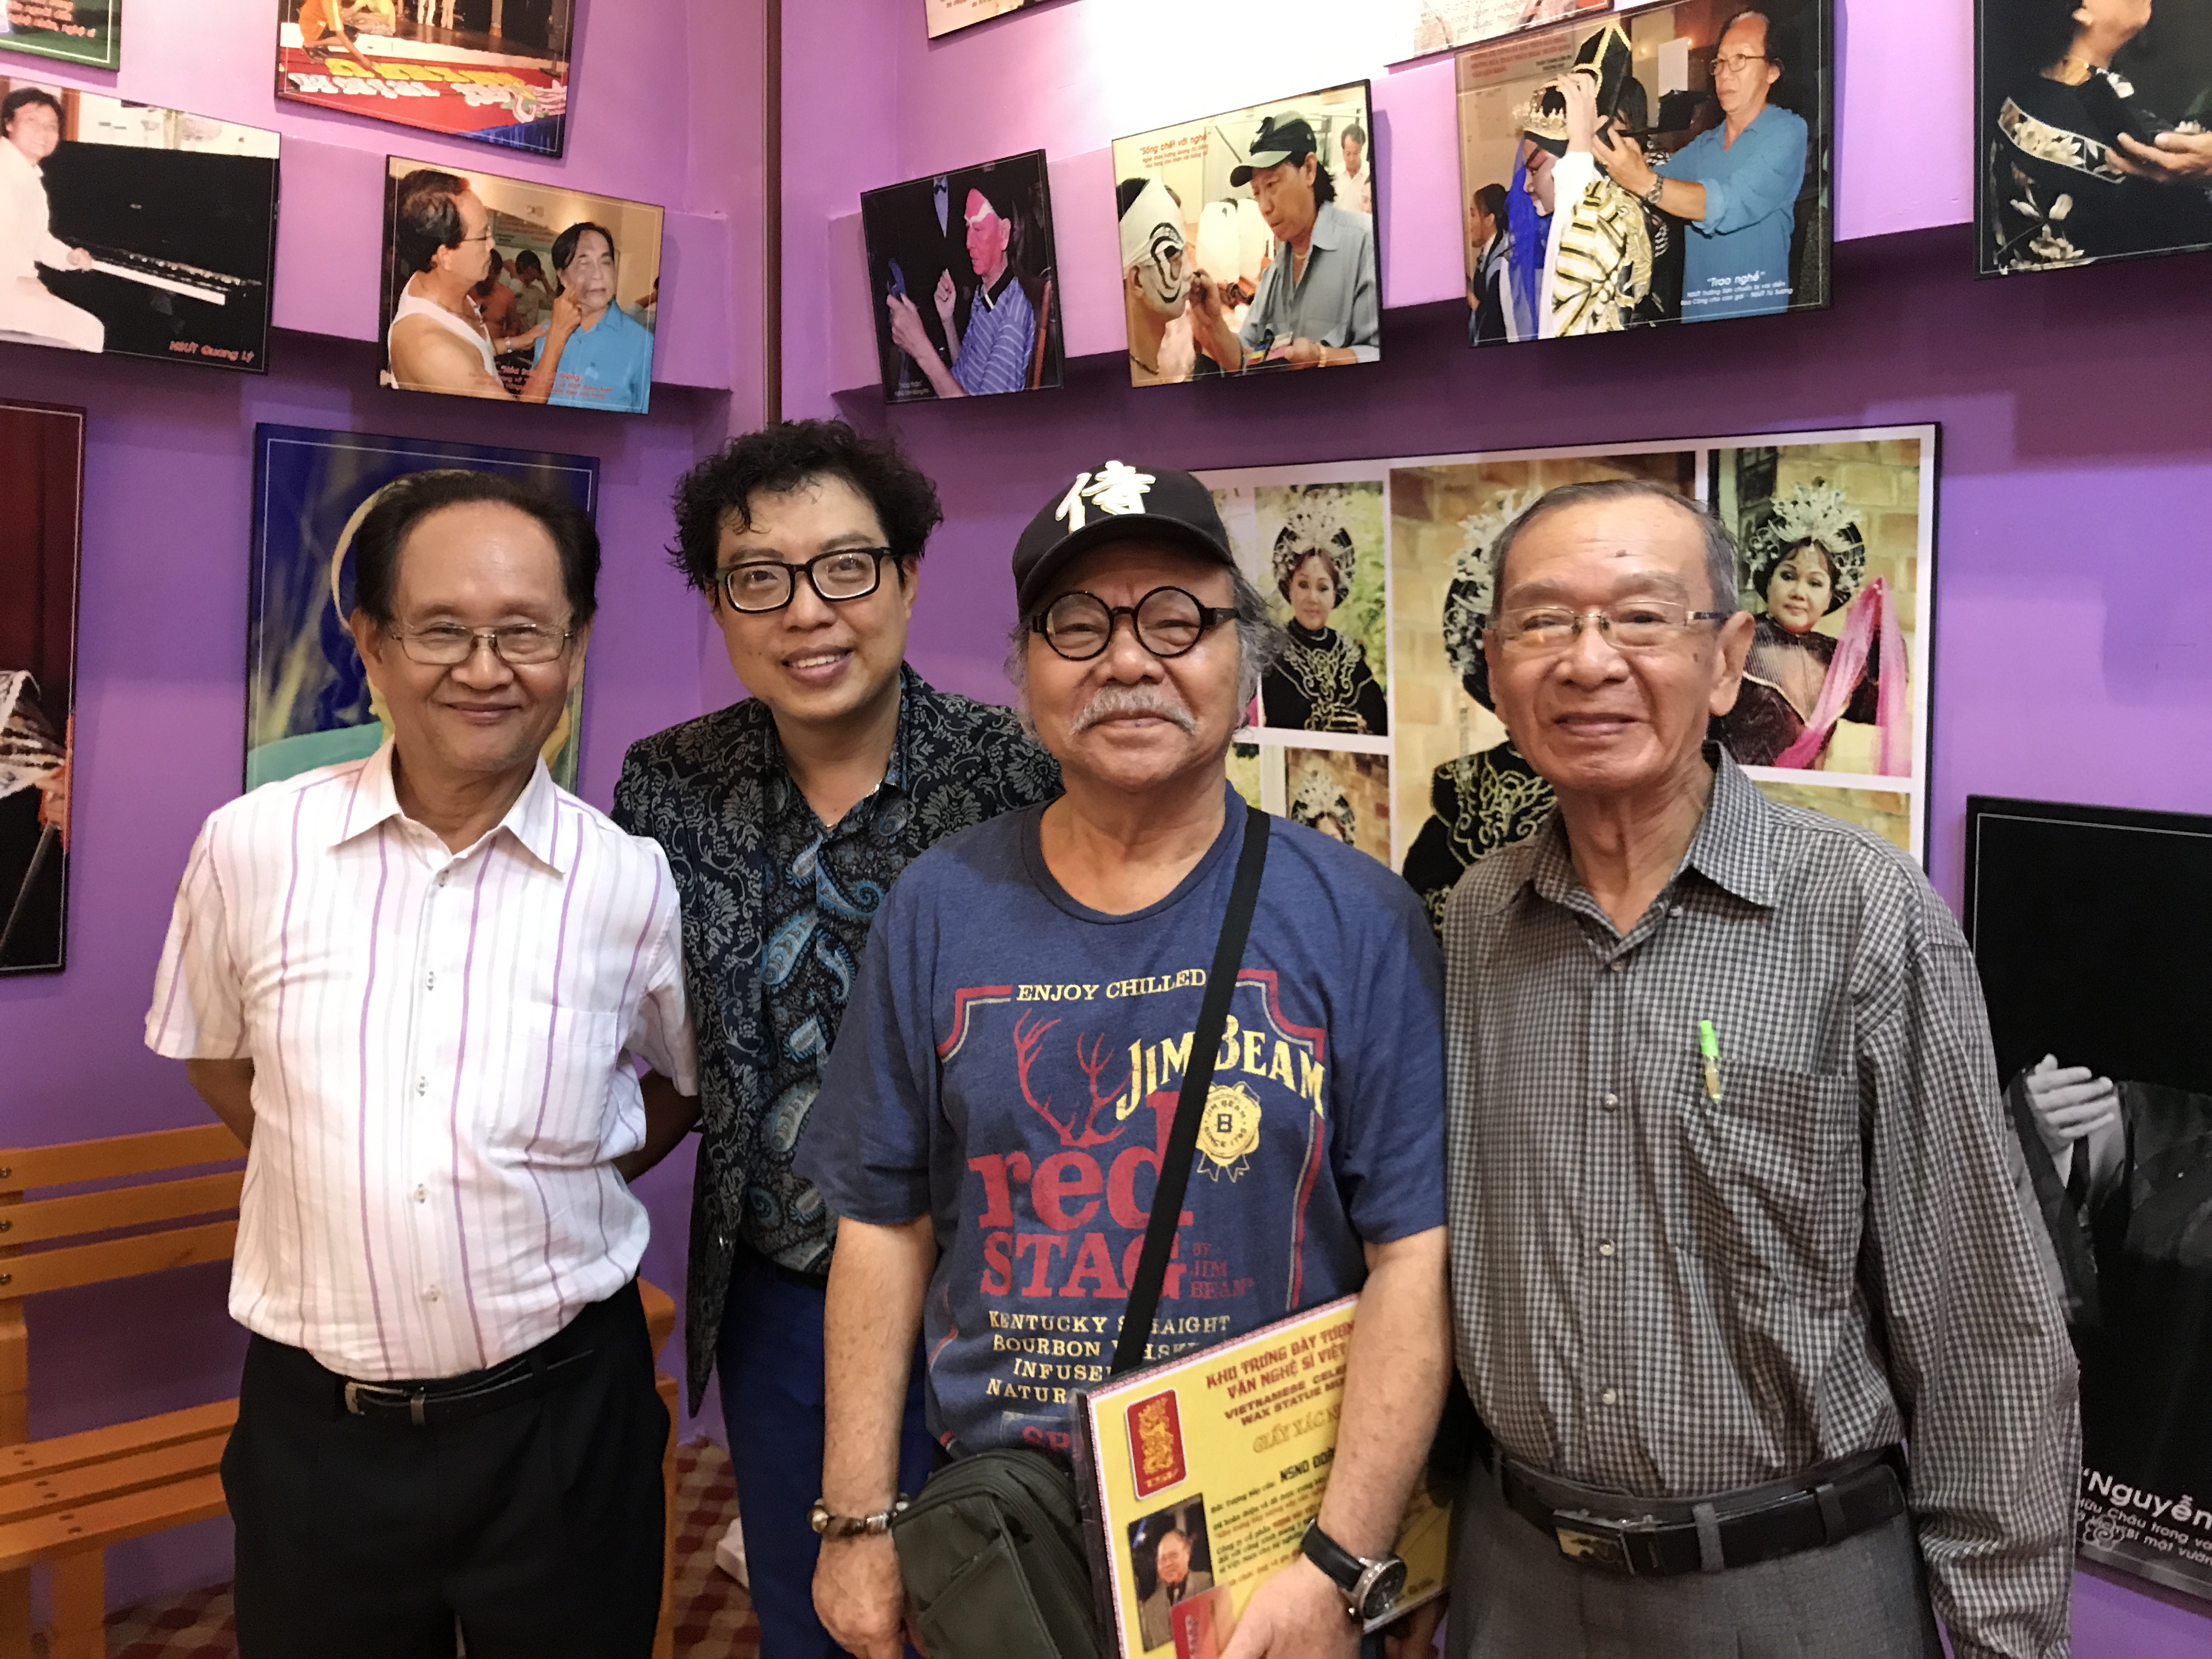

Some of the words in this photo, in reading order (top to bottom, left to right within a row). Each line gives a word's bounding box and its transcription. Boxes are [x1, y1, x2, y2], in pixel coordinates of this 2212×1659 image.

[1016, 984, 1099, 1001] ENJOY
[1105, 969, 1207, 999] CHILLED
[1116, 1031, 1196, 1121] JIM
[1214, 1014, 1325, 1120] BEAM
[1217, 1113, 1232, 1132] B
[967, 1091, 1194, 1231] red
[980, 1231, 1187, 1300] STAG
[989, 1311, 1108, 1333] KENTUCKY
[993, 1334, 1101, 1357] BOURBON
[1014, 1358, 1111, 1382] INFUSE
[1240, 1408, 1270, 1426] WAX
